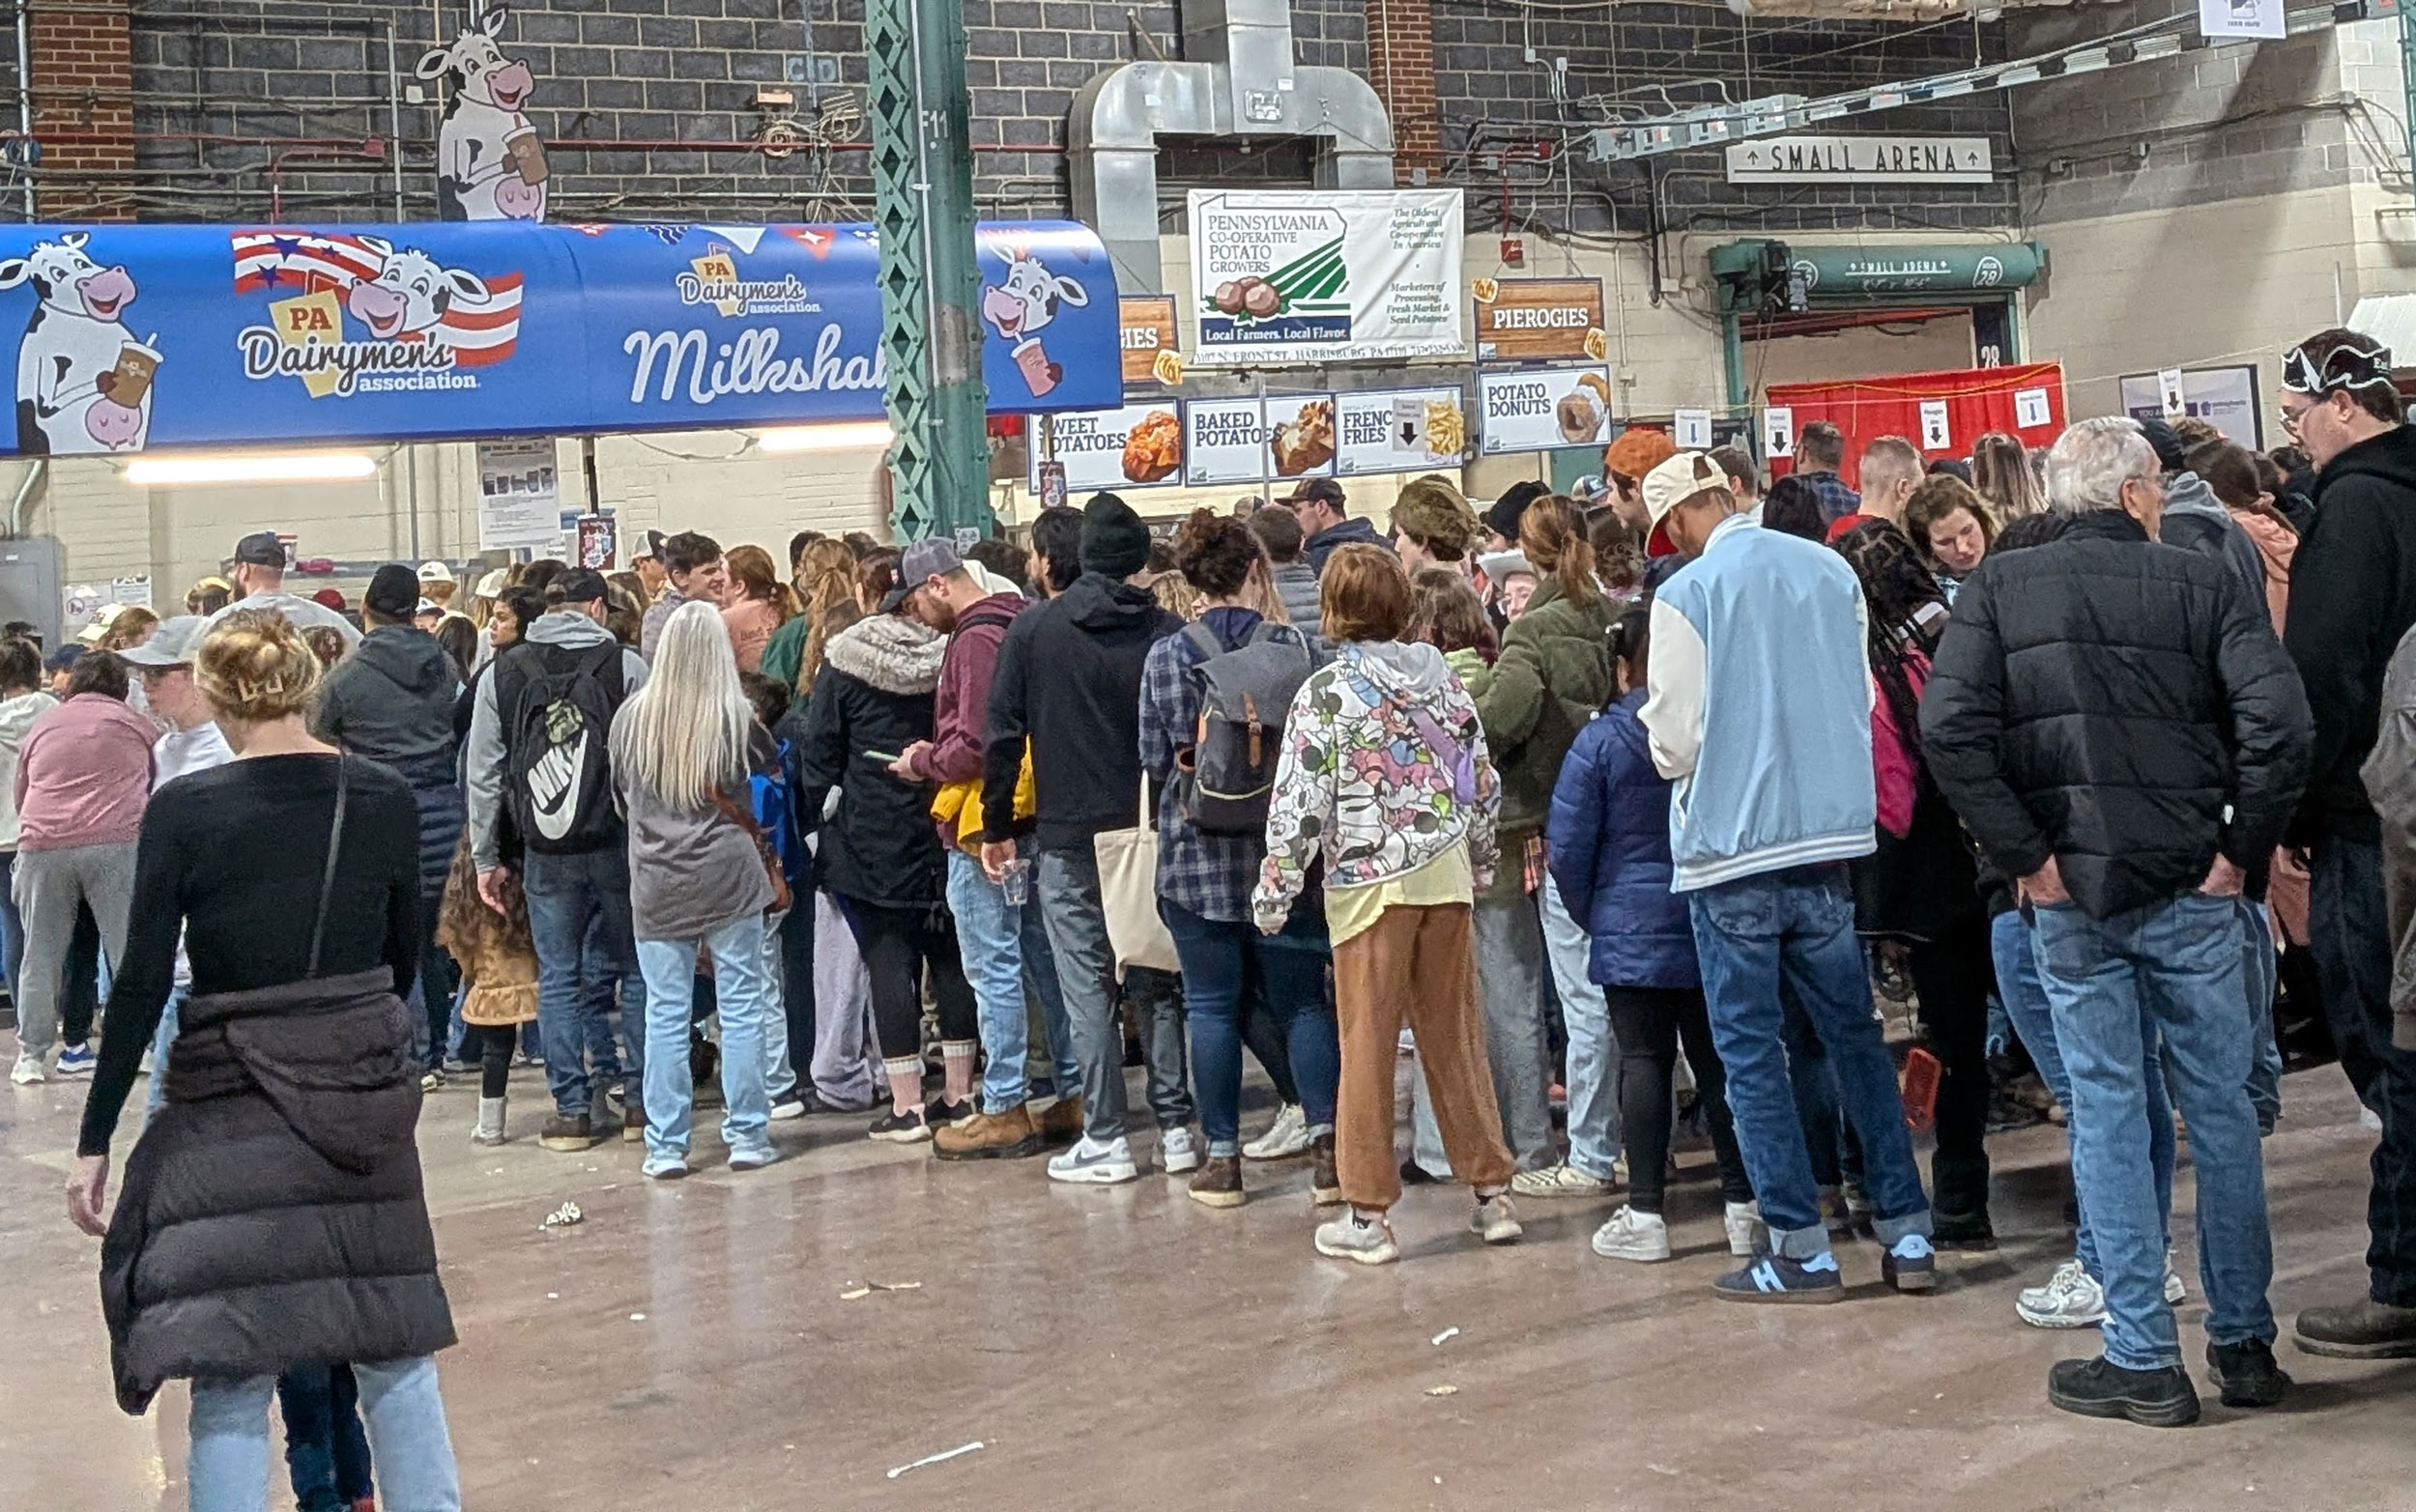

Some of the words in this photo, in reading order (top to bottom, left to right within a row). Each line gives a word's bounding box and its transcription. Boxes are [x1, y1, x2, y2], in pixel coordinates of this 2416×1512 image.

[1771, 144, 1855, 171] SMALL
[1875, 144, 1956, 171] ARENA
[1208, 215, 1329, 231] PENNSYLVANIA
[1209, 232, 1298, 243] CO-OPERATIVE
[1210, 244, 1272, 260] POTATO
[703, 262, 731, 276] PA
[1210, 261, 1271, 272] GROWERS
[1976, 270, 1999, 287] 28
[677, 274, 805, 314] Dairymen's
[749, 301, 821, 314] association
[290, 307, 332, 330] PA
[1493, 307, 1590, 329] PIEROGIES
[1205, 328, 1234, 341] Local
[1283, 327, 1310, 339] Local
[241, 329, 454, 393] Dairymen's
[623, 324, 888, 404] Milksha
[360, 373, 477, 391] association
[1488, 383, 1546, 401] POTATO
[1489, 399, 1552, 417] DONUTS
[1194, 412, 1254, 430] BAKED
[1343, 410, 1393, 428] FRENC
[1343, 426, 1387, 445] FRIES
[527, 742, 574, 811] NIK
